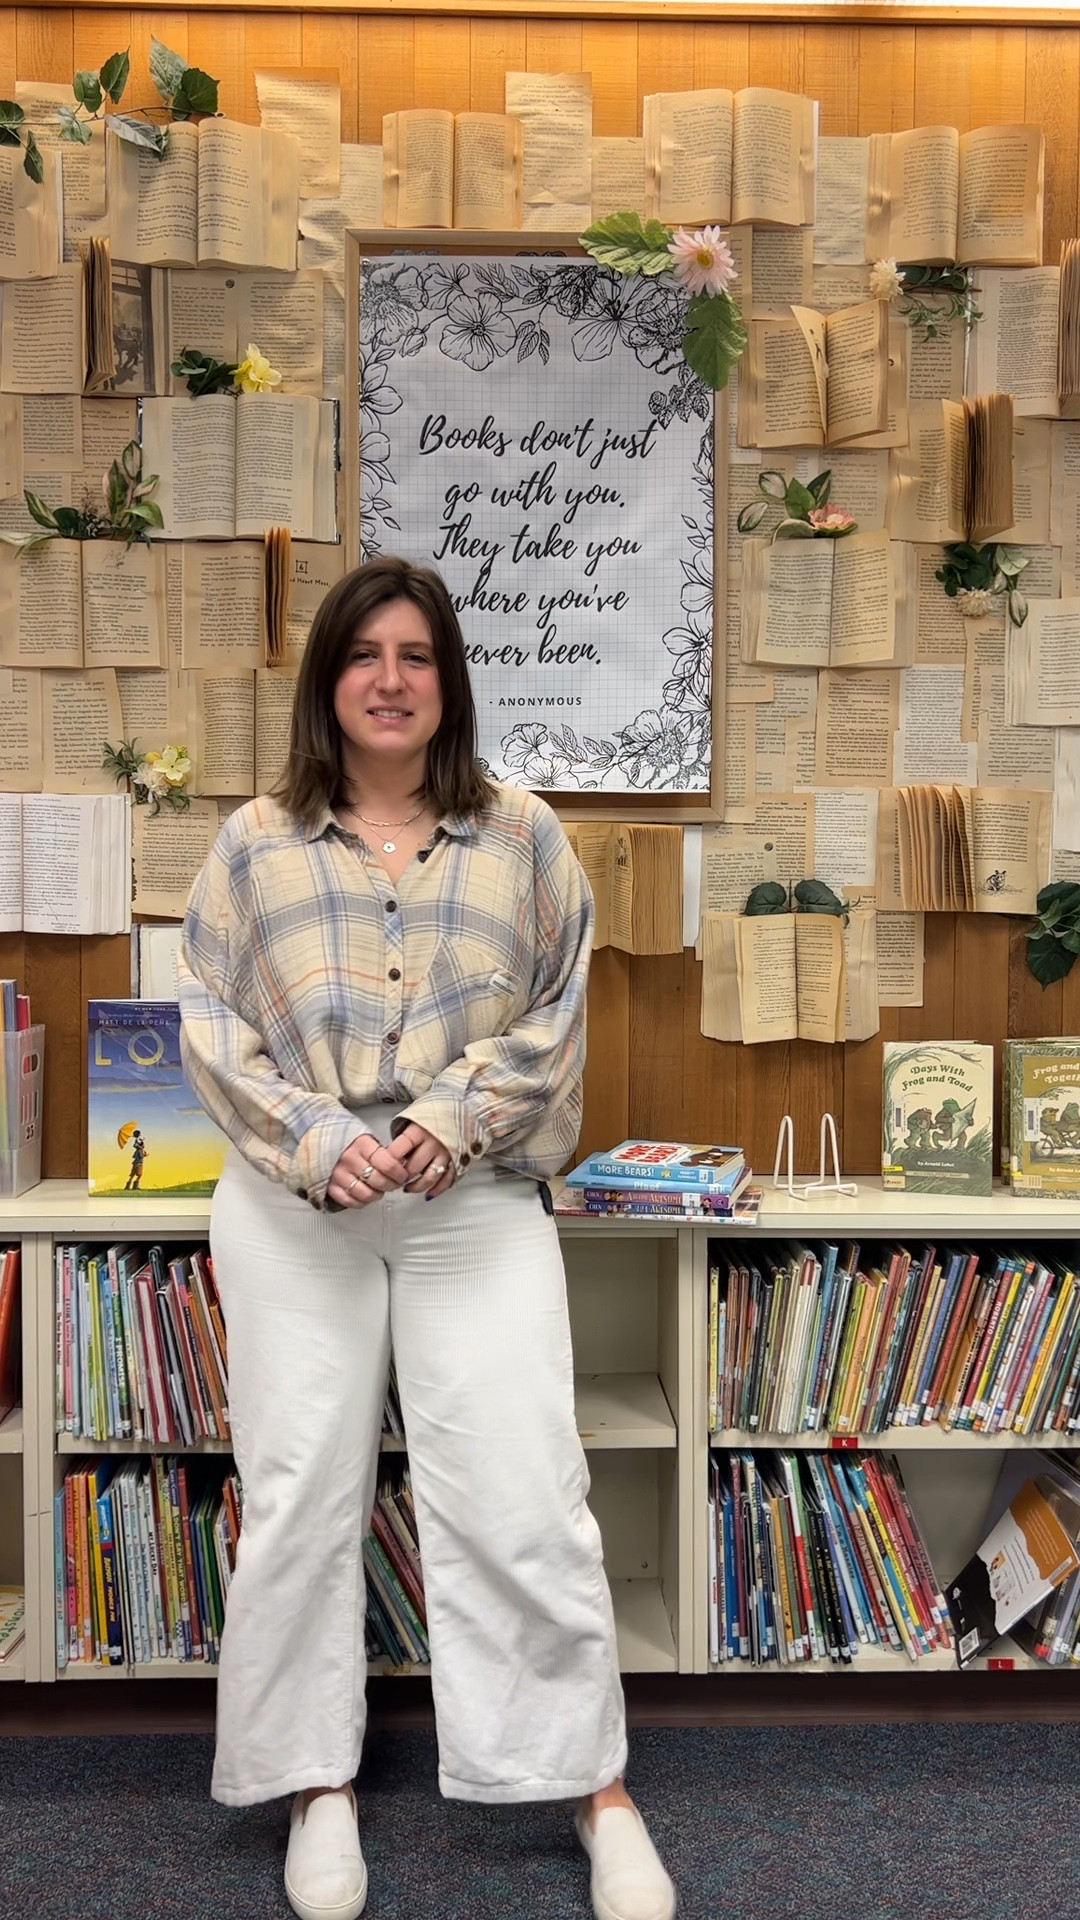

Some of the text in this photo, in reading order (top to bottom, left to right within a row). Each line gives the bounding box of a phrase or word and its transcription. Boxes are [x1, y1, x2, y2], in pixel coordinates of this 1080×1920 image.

[419, 414, 657, 471] Books don't just
[444, 461, 626, 523] go with you.
[432, 513, 643, 576] They take you
[449, 568, 631, 630] where you've
[537, 625, 603, 666] been.
[498, 696, 583, 707] ANONYMOUS
[95, 1029, 165, 1066] LO
[910, 1064, 965, 1076] Days With
[1032, 1065, 1058, 1079] Frog
[1044, 1074, 1080, 1083] Togeth
[902, 1075, 973, 1092] Frog and Toad
[597, 1165, 654, 1177] MORE BEARS!
[633, 1180, 660, 1190] Ploof
[115, 1344, 125, 1388] PROMISE
[841, 1438, 848, 1448] K
[172, 1516, 181, 1540] DON'T
[175, 1542, 183, 1555] SAY
[103, 1556, 113, 1583] BATMAN
[176, 1558, 185, 1578] THAT
[998, 1660, 1003, 1669] L
